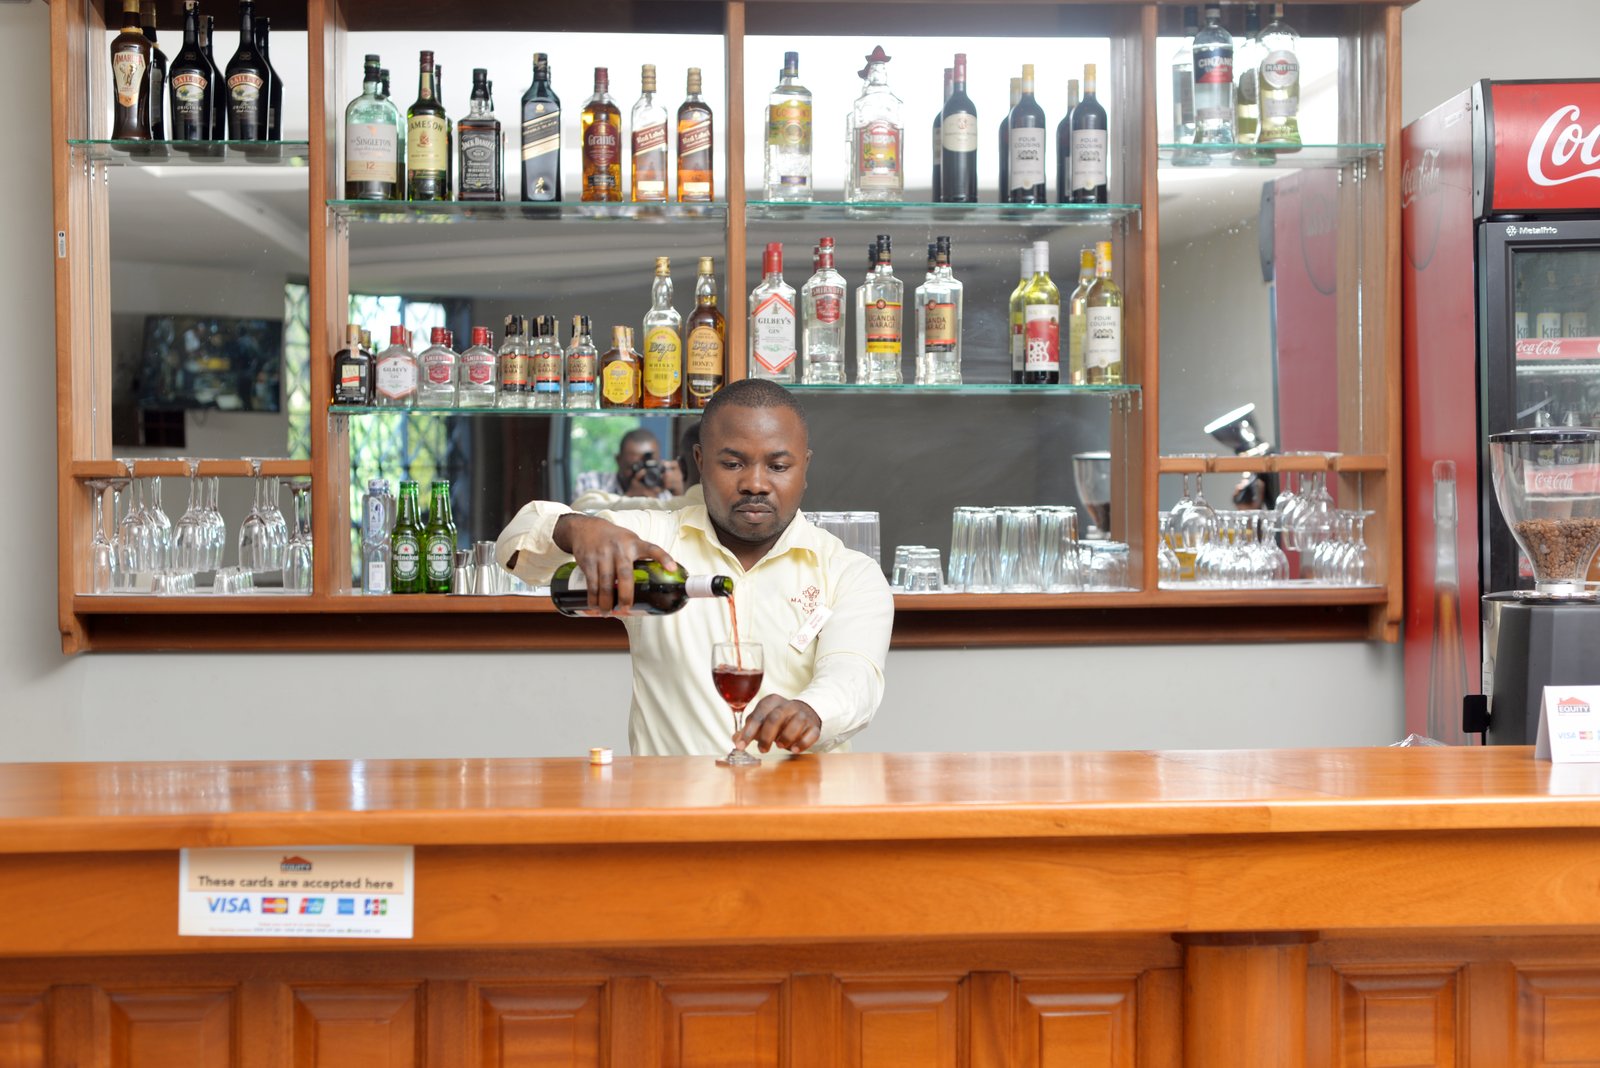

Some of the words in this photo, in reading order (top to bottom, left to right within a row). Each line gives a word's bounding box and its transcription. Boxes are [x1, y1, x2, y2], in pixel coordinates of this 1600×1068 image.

[1266, 64, 1297, 72] MARTINI
[174, 74, 206, 86] BAILEYS
[230, 73, 262, 86] BAILEYS
[408, 120, 443, 132] JAMESON
[355, 136, 391, 147] SINGLETON
[1519, 226, 1558, 236] Metalfrio
[811, 286, 844, 297] SMIRNOFF
[757, 316, 792, 325] GILBEY'S
[1028, 340, 1050, 354] DRY
[692, 360, 714, 368] HONEY
[1558, 705, 1590, 713] EQUITY
[1557, 732, 1577, 740] VISA
[198, 876, 235, 888] These
[239, 876, 273, 888] cards
[277, 879, 298, 888] are
[302, 877, 361, 891] accepted
[365, 878, 394, 889] here
[207, 897, 252, 914] VISA
